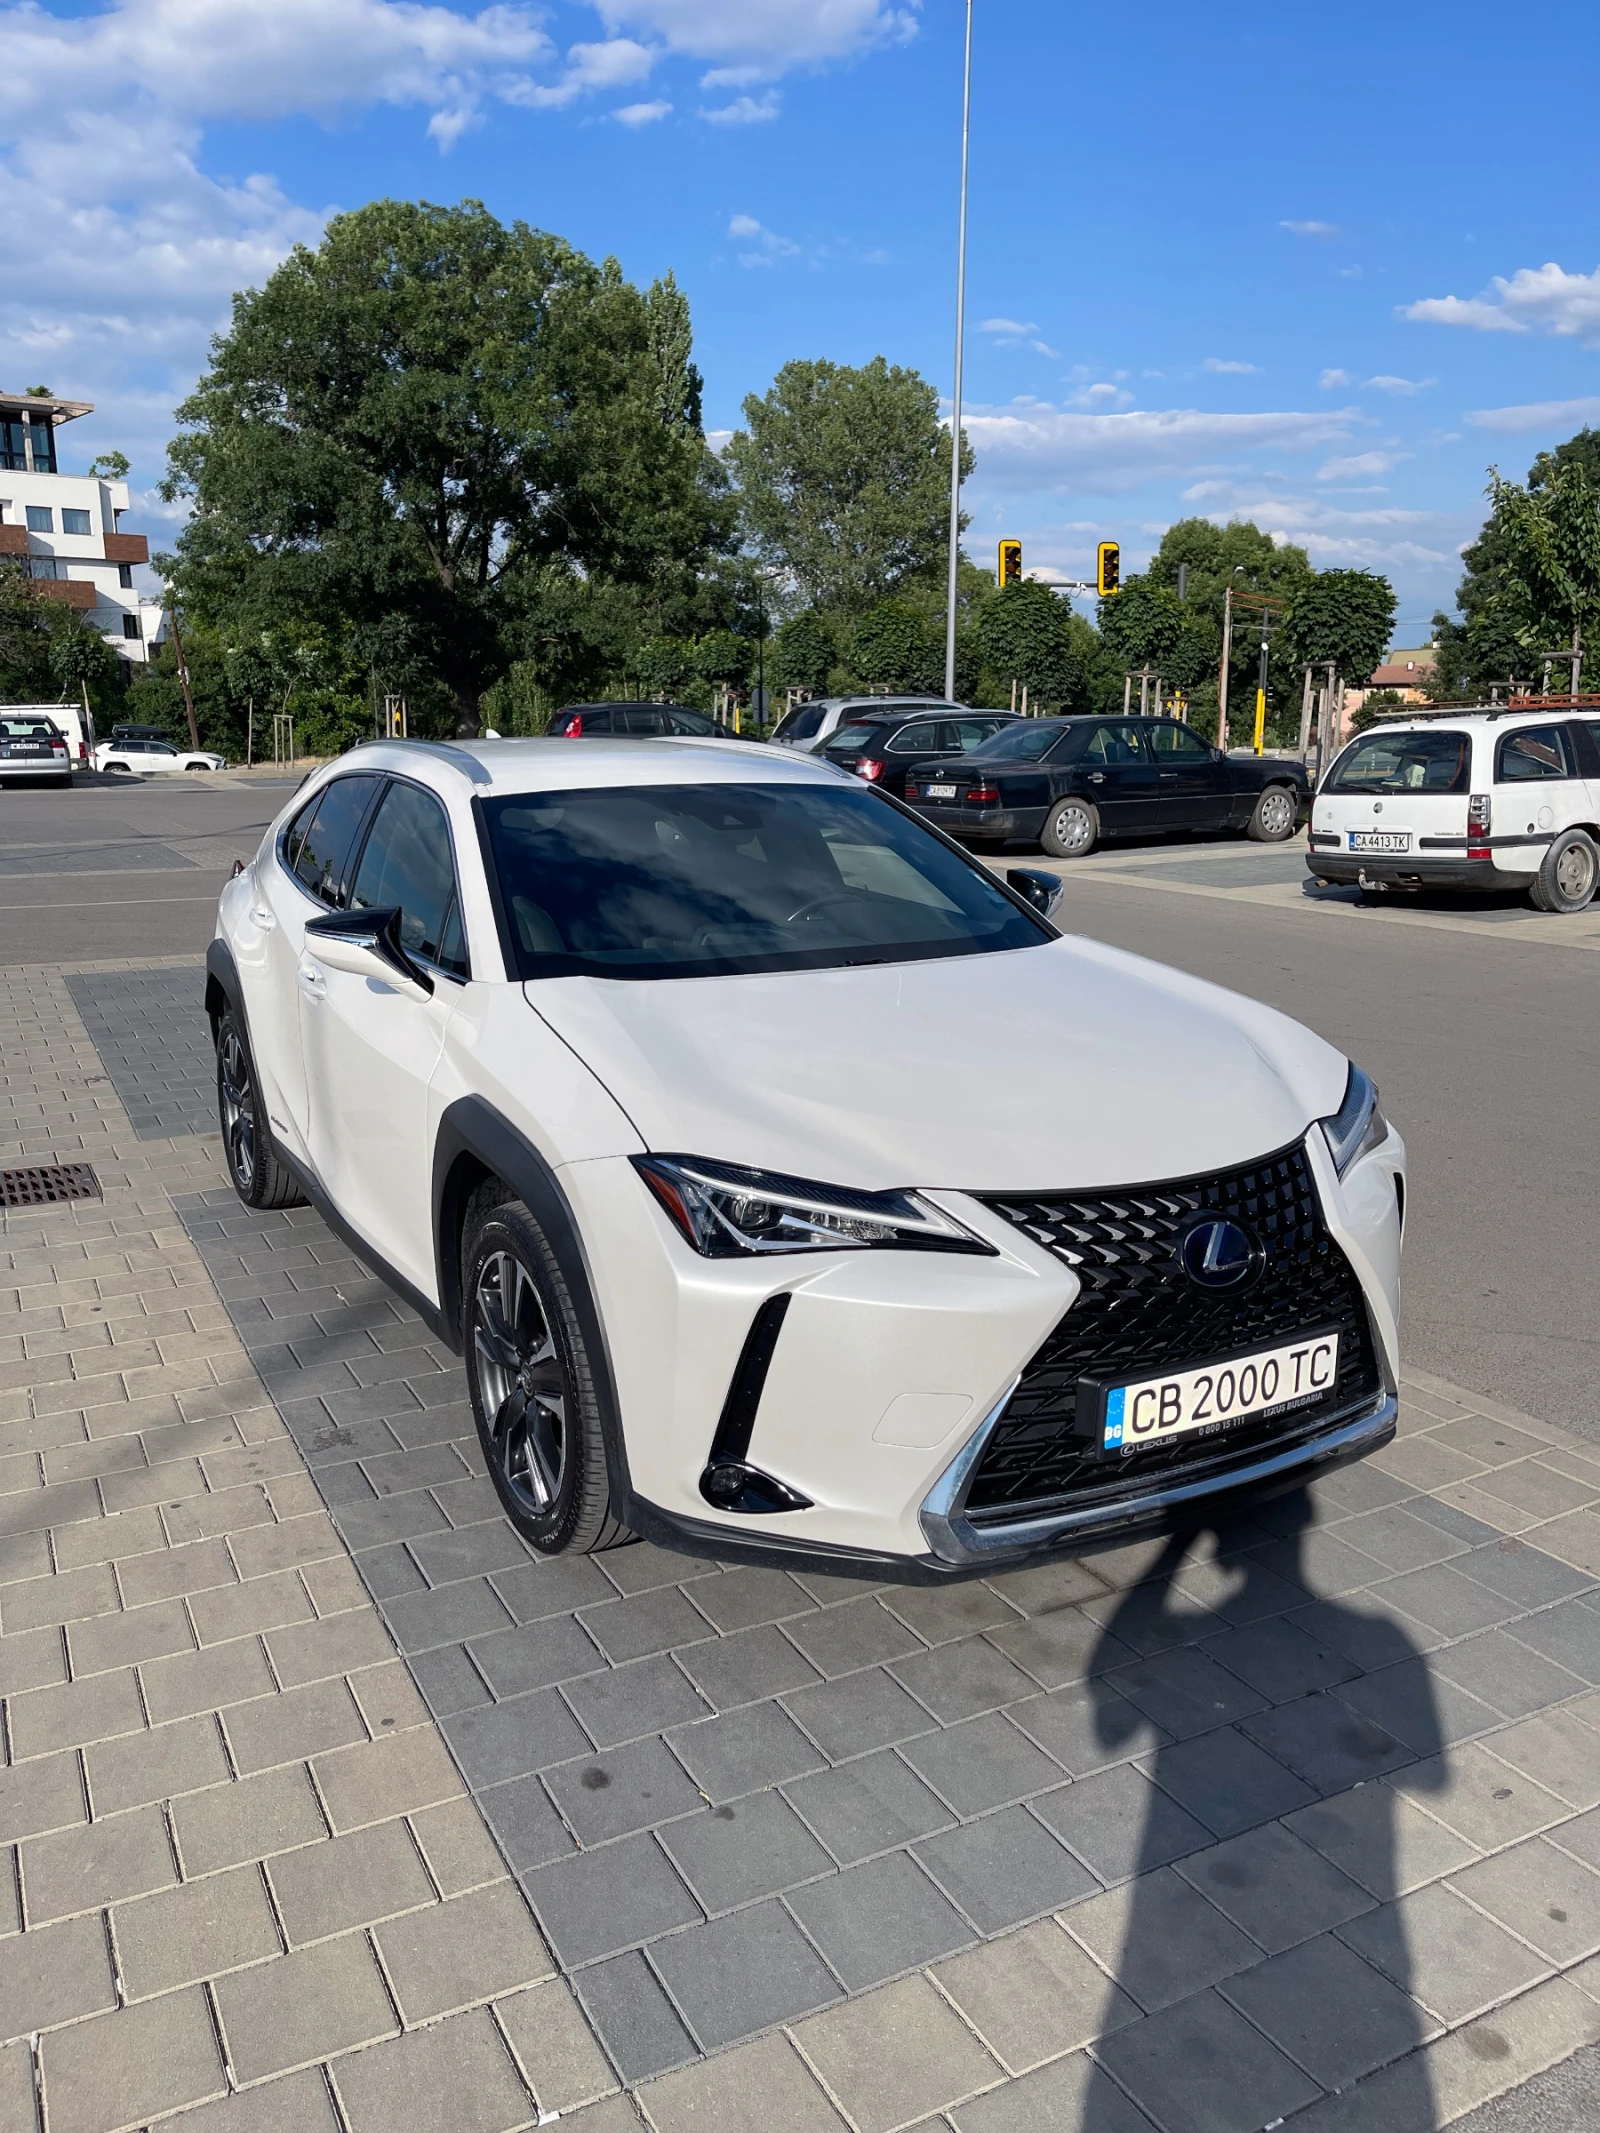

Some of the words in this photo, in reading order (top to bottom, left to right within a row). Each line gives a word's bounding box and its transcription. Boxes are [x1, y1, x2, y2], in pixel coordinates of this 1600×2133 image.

[1355, 835, 1367, 847] CA
[1368, 835, 1391, 848] 4413
[1392, 836, 1406, 848] TK
[1132, 1383, 1181, 1434] CB
[1191, 1358, 1280, 1421] 2000
[1290, 1344, 1331, 1394] TC
[1263, 1403, 1286, 1418] LEXUS
[1286, 1392, 1323, 1410] BULGARIA
[1104, 1424, 1122, 1441] BG
[1205, 1423, 1220, 1434] 800
[1222, 1420, 1231, 1430] 15
[1233, 1415, 1245, 1427] 111
[1136, 1434, 1178, 1452] LEXUS
